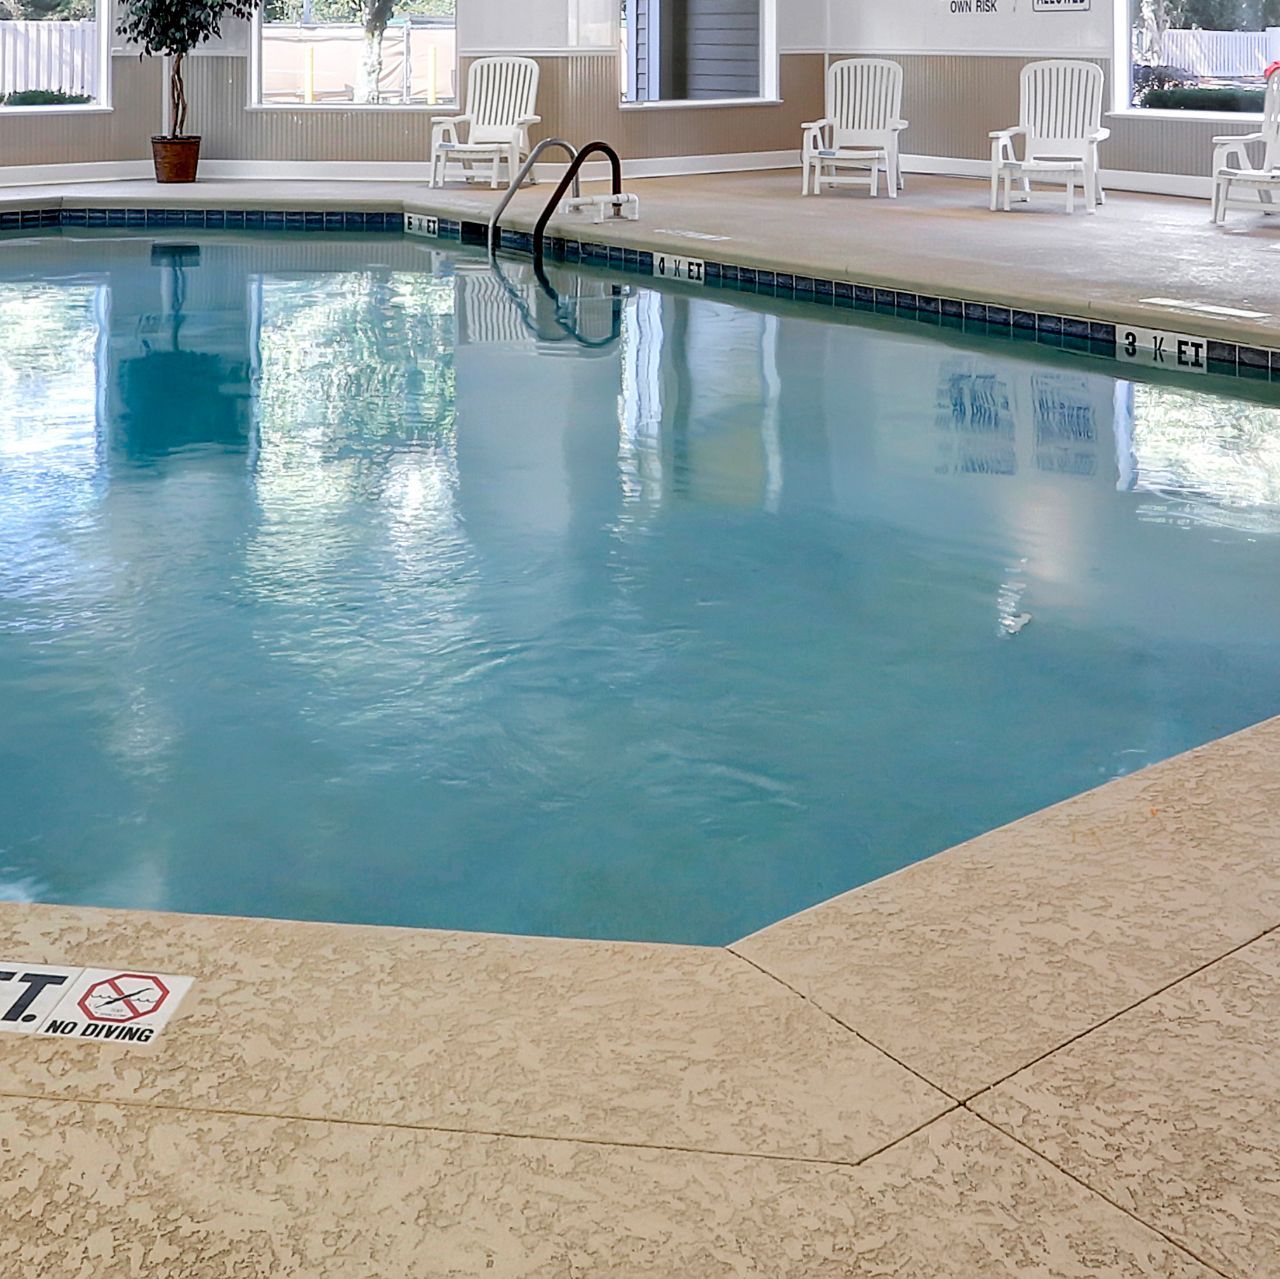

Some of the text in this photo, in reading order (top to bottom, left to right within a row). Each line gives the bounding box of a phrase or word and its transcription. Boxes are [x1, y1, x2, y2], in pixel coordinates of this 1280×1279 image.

[950, 0, 997, 14] OWN RISK
[44, 1018, 155, 1043] NO DIVING
